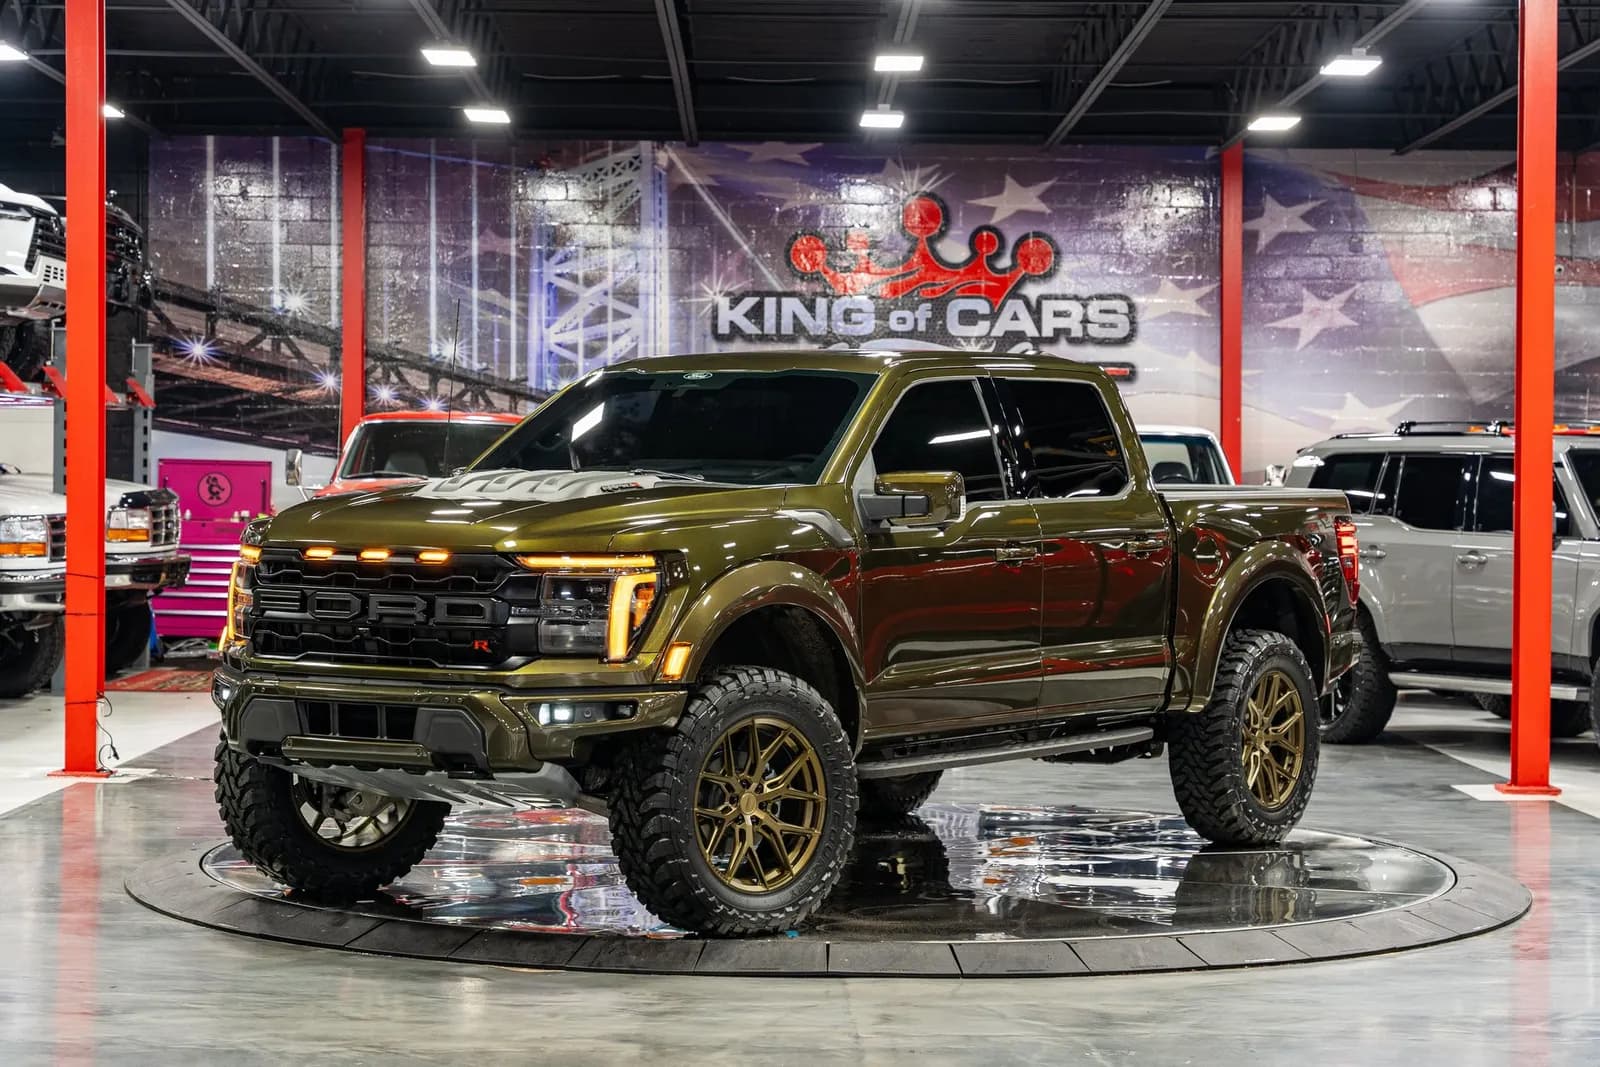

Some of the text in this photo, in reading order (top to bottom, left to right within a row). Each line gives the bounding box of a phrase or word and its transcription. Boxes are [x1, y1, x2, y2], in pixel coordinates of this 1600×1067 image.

[717, 295, 1131, 338] KING of CARS
[249, 587, 510, 627] FORD
